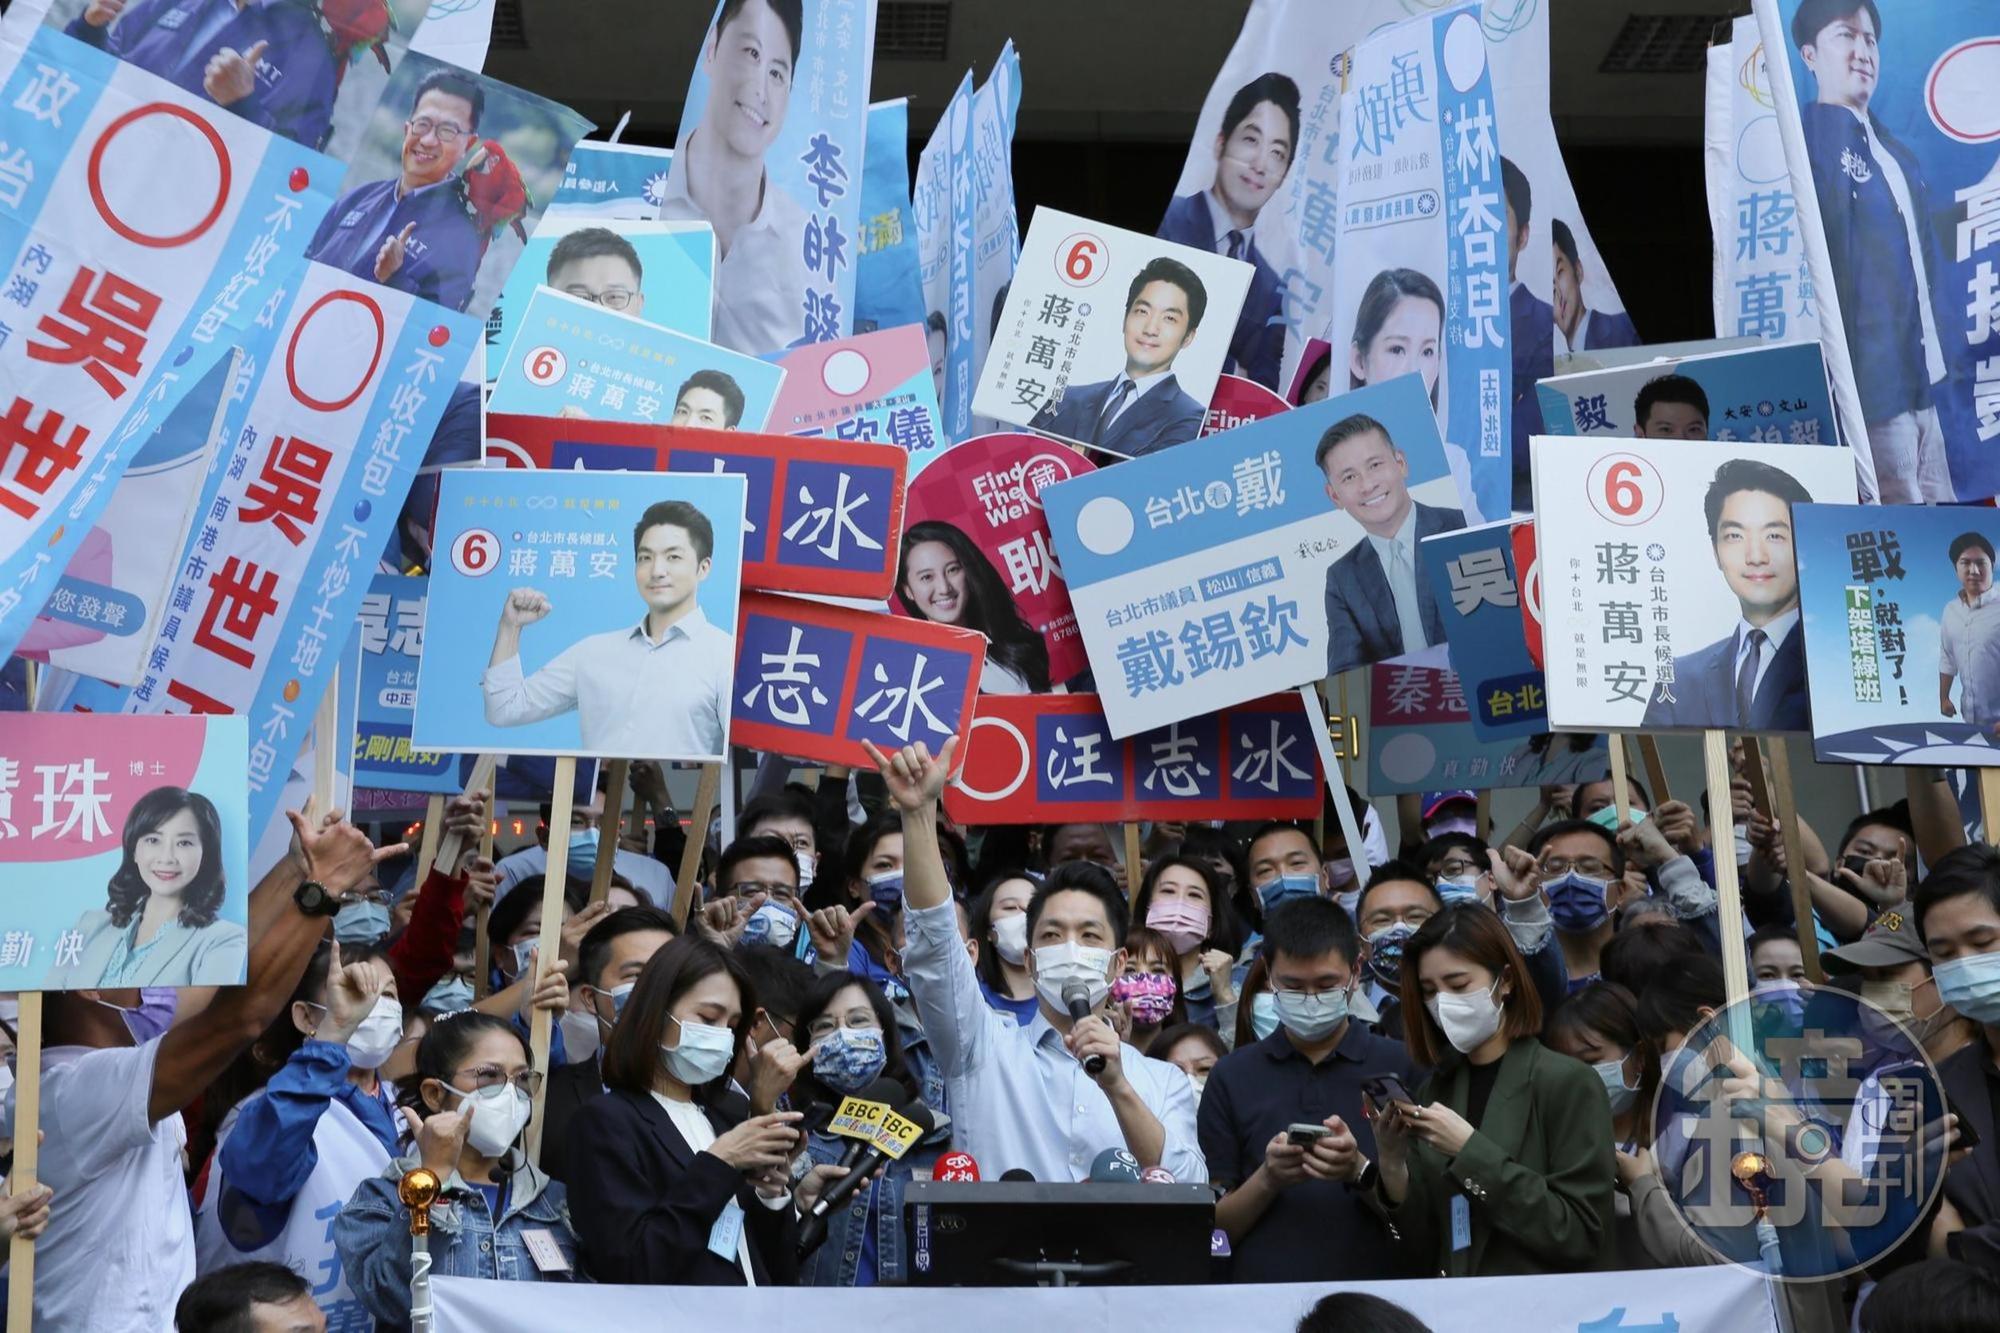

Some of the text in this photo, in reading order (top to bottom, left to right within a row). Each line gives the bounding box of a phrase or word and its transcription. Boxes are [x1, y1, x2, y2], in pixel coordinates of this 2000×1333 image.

[1066, 240, 1098, 281] 6
[1735, 187, 1796, 340] 蔣萬
[531, 350, 558, 380] 6
[1010, 293, 1075, 411] 蔣萬安
[1043, 318, 1087, 417] 台北市長候選人
[565, 372, 661, 421] 蔣萬安
[589, 361, 664, 396] 台北市長候選人
[361, 347, 446, 497] 不收紅包
[791, 405, 936, 452] 欣儀
[972, 461, 1025, 497] Find
[978, 486, 1024, 512] The
[1605, 460, 1644, 517] 6
[782, 472, 885, 561] 冰
[985, 497, 1031, 528] Wei
[462, 534, 488, 570] 6
[508, 547, 619, 579] 蔣萬安
[527, 530, 619, 547] 台北市長候選人
[997, 529, 1065, 596] 耿
[1845, 530, 1908, 584] 戰
[163, 433, 335, 714] 吳世
[1205, 561, 1279, 596] 松山 信義
[50, 585, 129, 630] 您發聲
[290, 523, 369, 679] 不炒土地
[1105, 585, 1199, 629] 台北市議員
[1594, 541, 1649, 704] 蔣萬安
[1115, 594, 1310, 699] 戴錫欽
[1649, 565, 1677, 704] 台北市長候選人
[1845, 585, 1882, 703] 下架塔綠班
[385, 691, 412, 706] 中正
[386, 668, 417, 686] 台北
[743, 626, 956, 742] 志冰
[128, 760, 167, 777] 博士
[1045, 719, 1313, 797] 汪志冰
[0, 756, 114, 844] 珠
